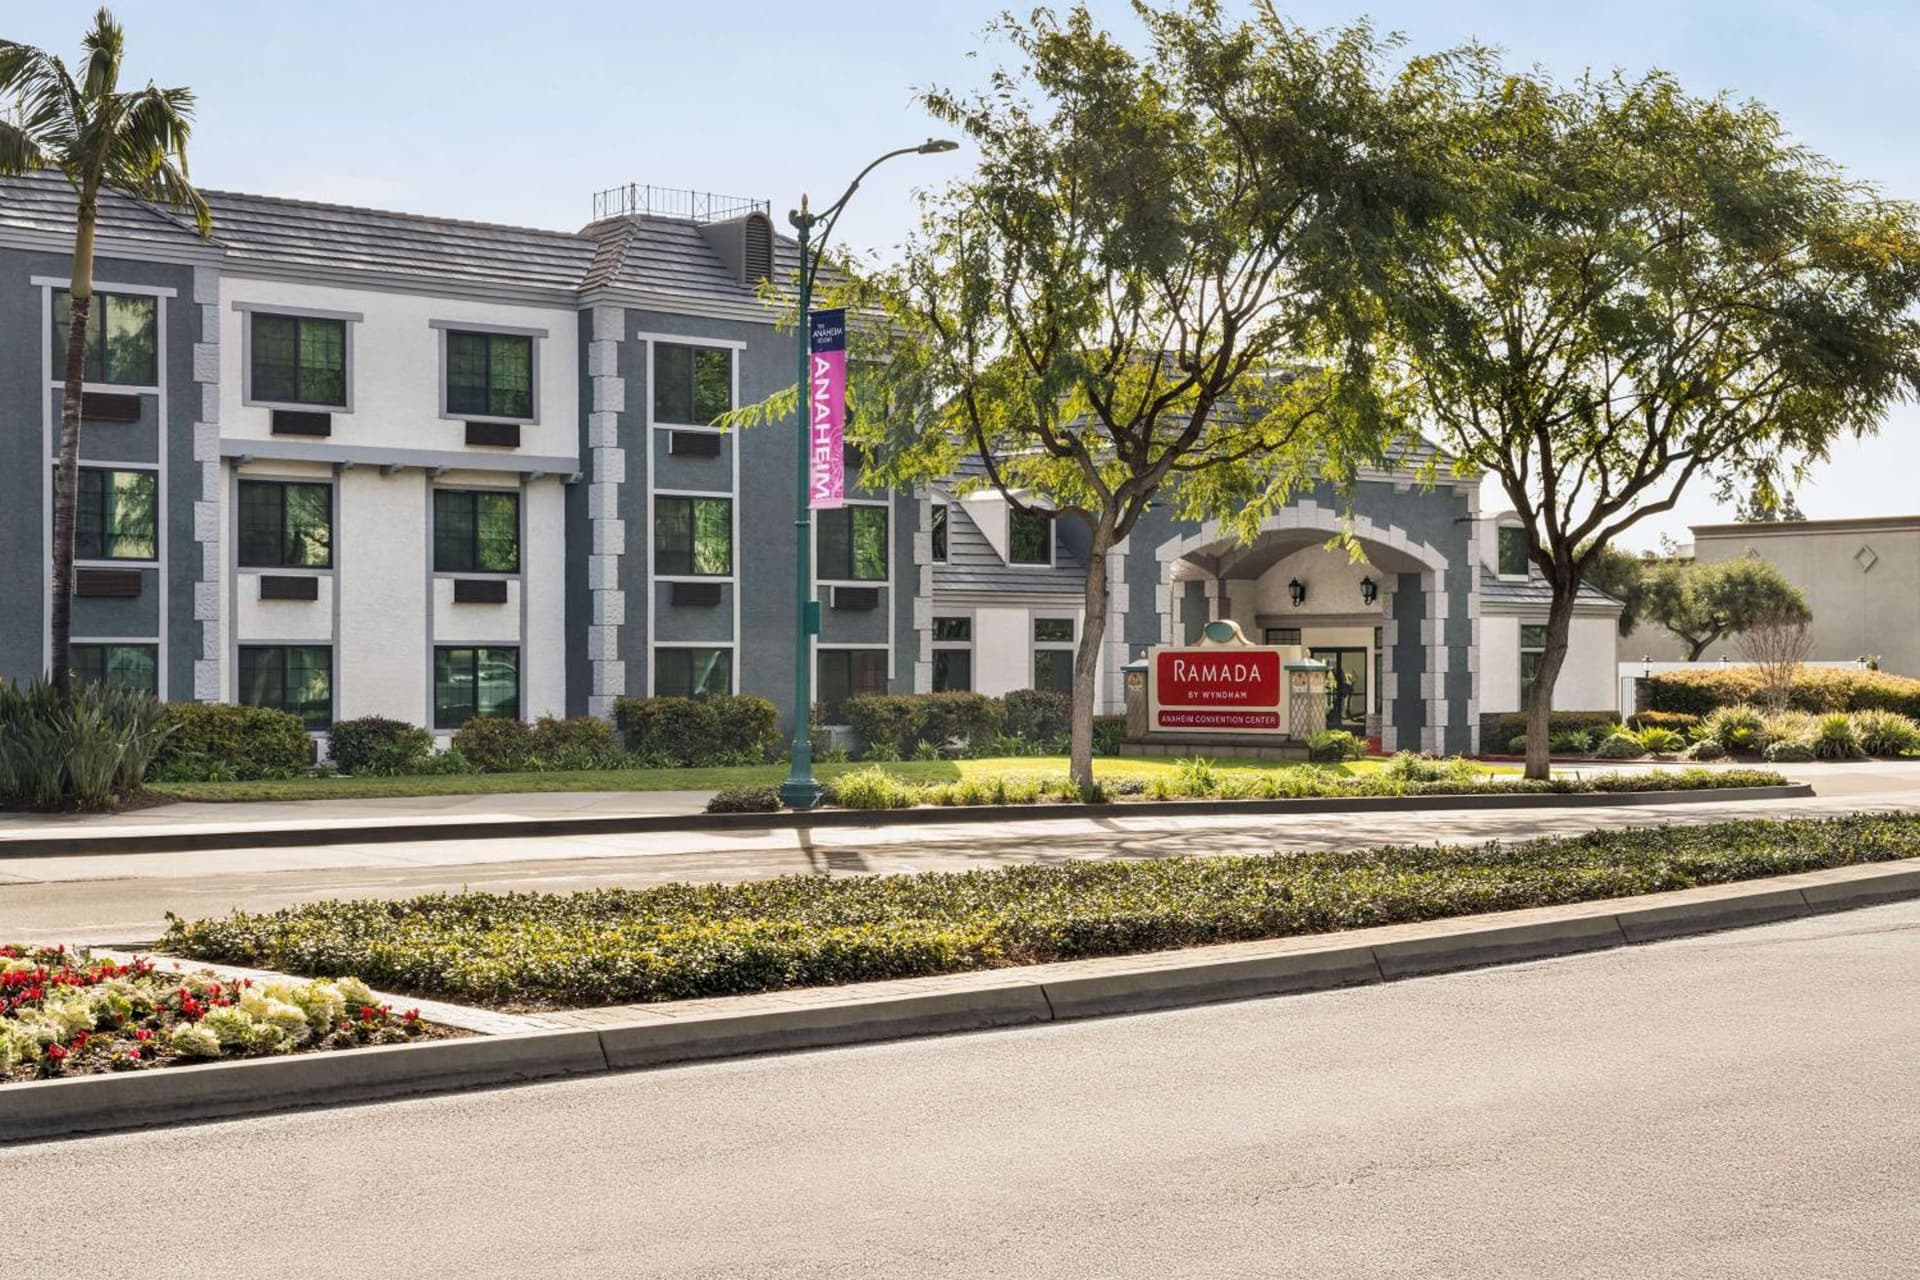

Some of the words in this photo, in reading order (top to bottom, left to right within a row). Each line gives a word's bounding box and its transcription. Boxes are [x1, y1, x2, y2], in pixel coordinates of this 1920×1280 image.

[812, 327, 843, 338] ANAHEIM
[814, 356, 831, 499] ANAHEIM
[1173, 659, 1262, 682] RAMADA
[1187, 690, 1199, 699] BY
[1202, 690, 1248, 699] WYNDHAM
[1161, 714, 1194, 723] ANAHEIM
[1194, 715, 1244, 724] CONVENTION
[1244, 716, 1276, 725] CENTER
